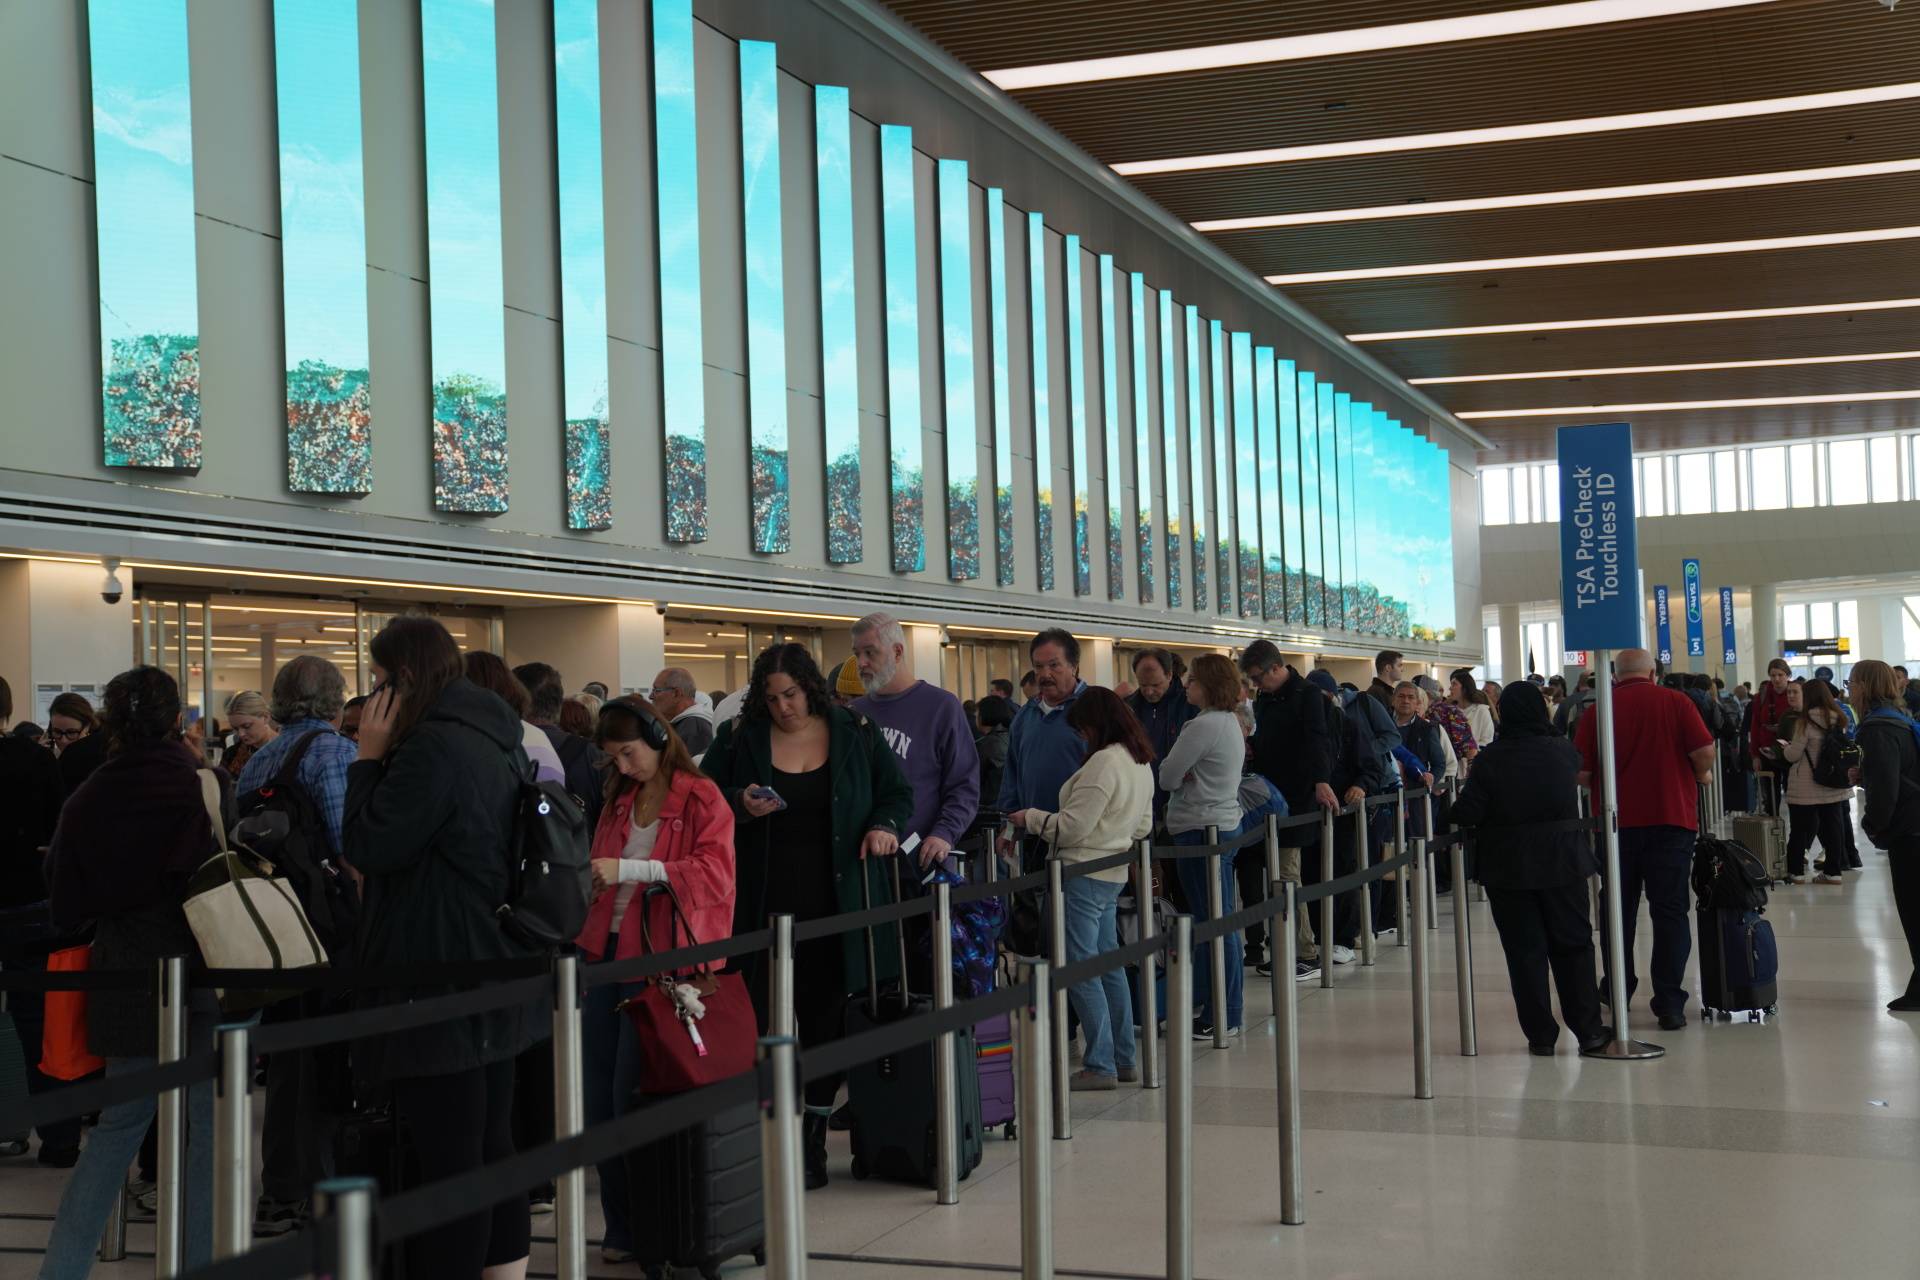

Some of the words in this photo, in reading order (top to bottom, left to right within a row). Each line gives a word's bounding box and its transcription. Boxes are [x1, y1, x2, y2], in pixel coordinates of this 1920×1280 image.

[1596, 473, 1616, 495] ID
[1573, 466, 1594, 560] PreCheck
[1597, 501, 1619, 601] Touchless
[1577, 565, 1596, 609] TSA
[1689, 582, 1697, 595] TSA
[1658, 589, 1667, 626] GENERAL
[1723, 591, 1732, 627] GENERAL
[1660, 653, 1670, 661] 20
[1693, 642, 1700, 651] 5
[1725, 652, 1735, 660] 20
